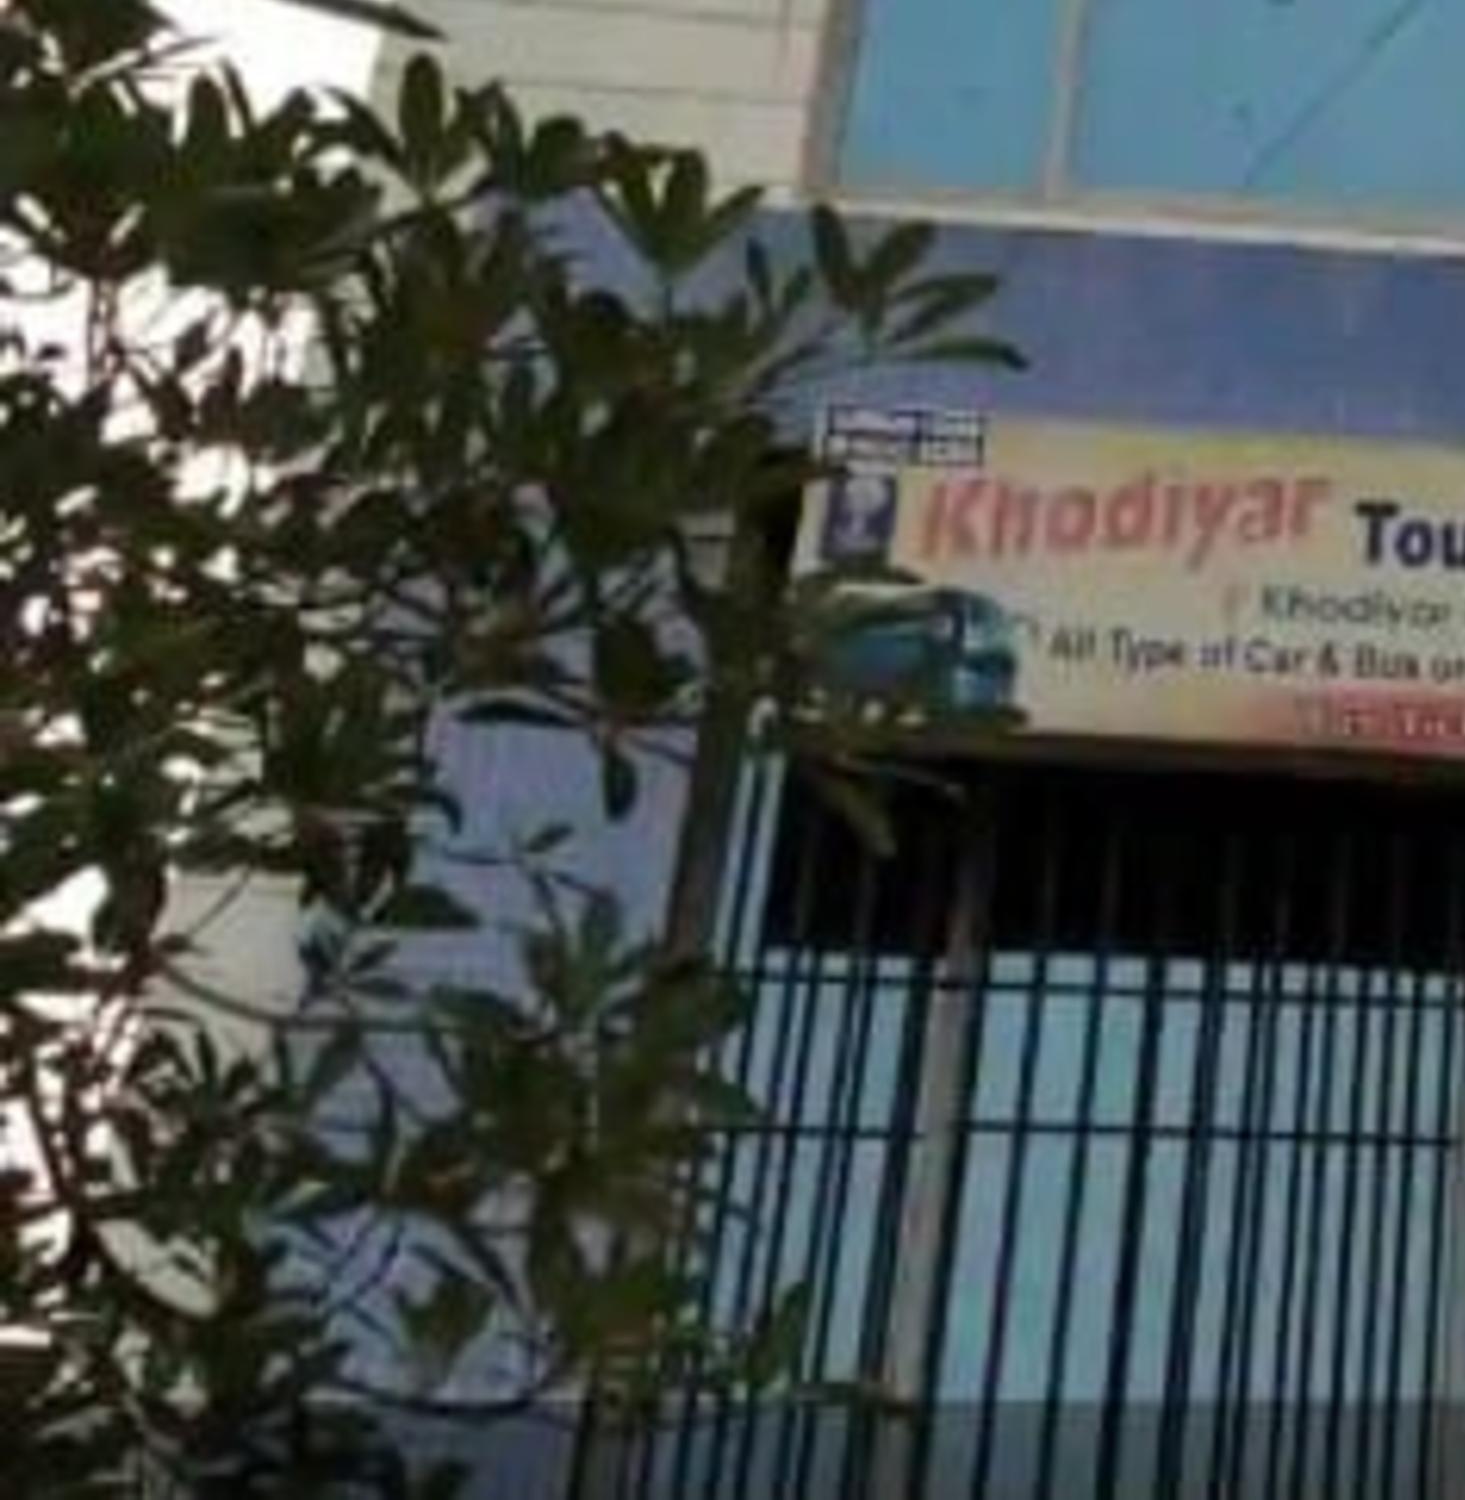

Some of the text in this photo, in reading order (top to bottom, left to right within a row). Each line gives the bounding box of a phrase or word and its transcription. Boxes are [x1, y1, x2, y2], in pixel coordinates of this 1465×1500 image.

[920, 471, 1332, 570] Khodiyar
[1048, 626, 1097, 661] All
[1110, 627, 1185, 674] Type
[1199, 636, 1235, 666] of
[1245, 638, 1303, 674] Car
